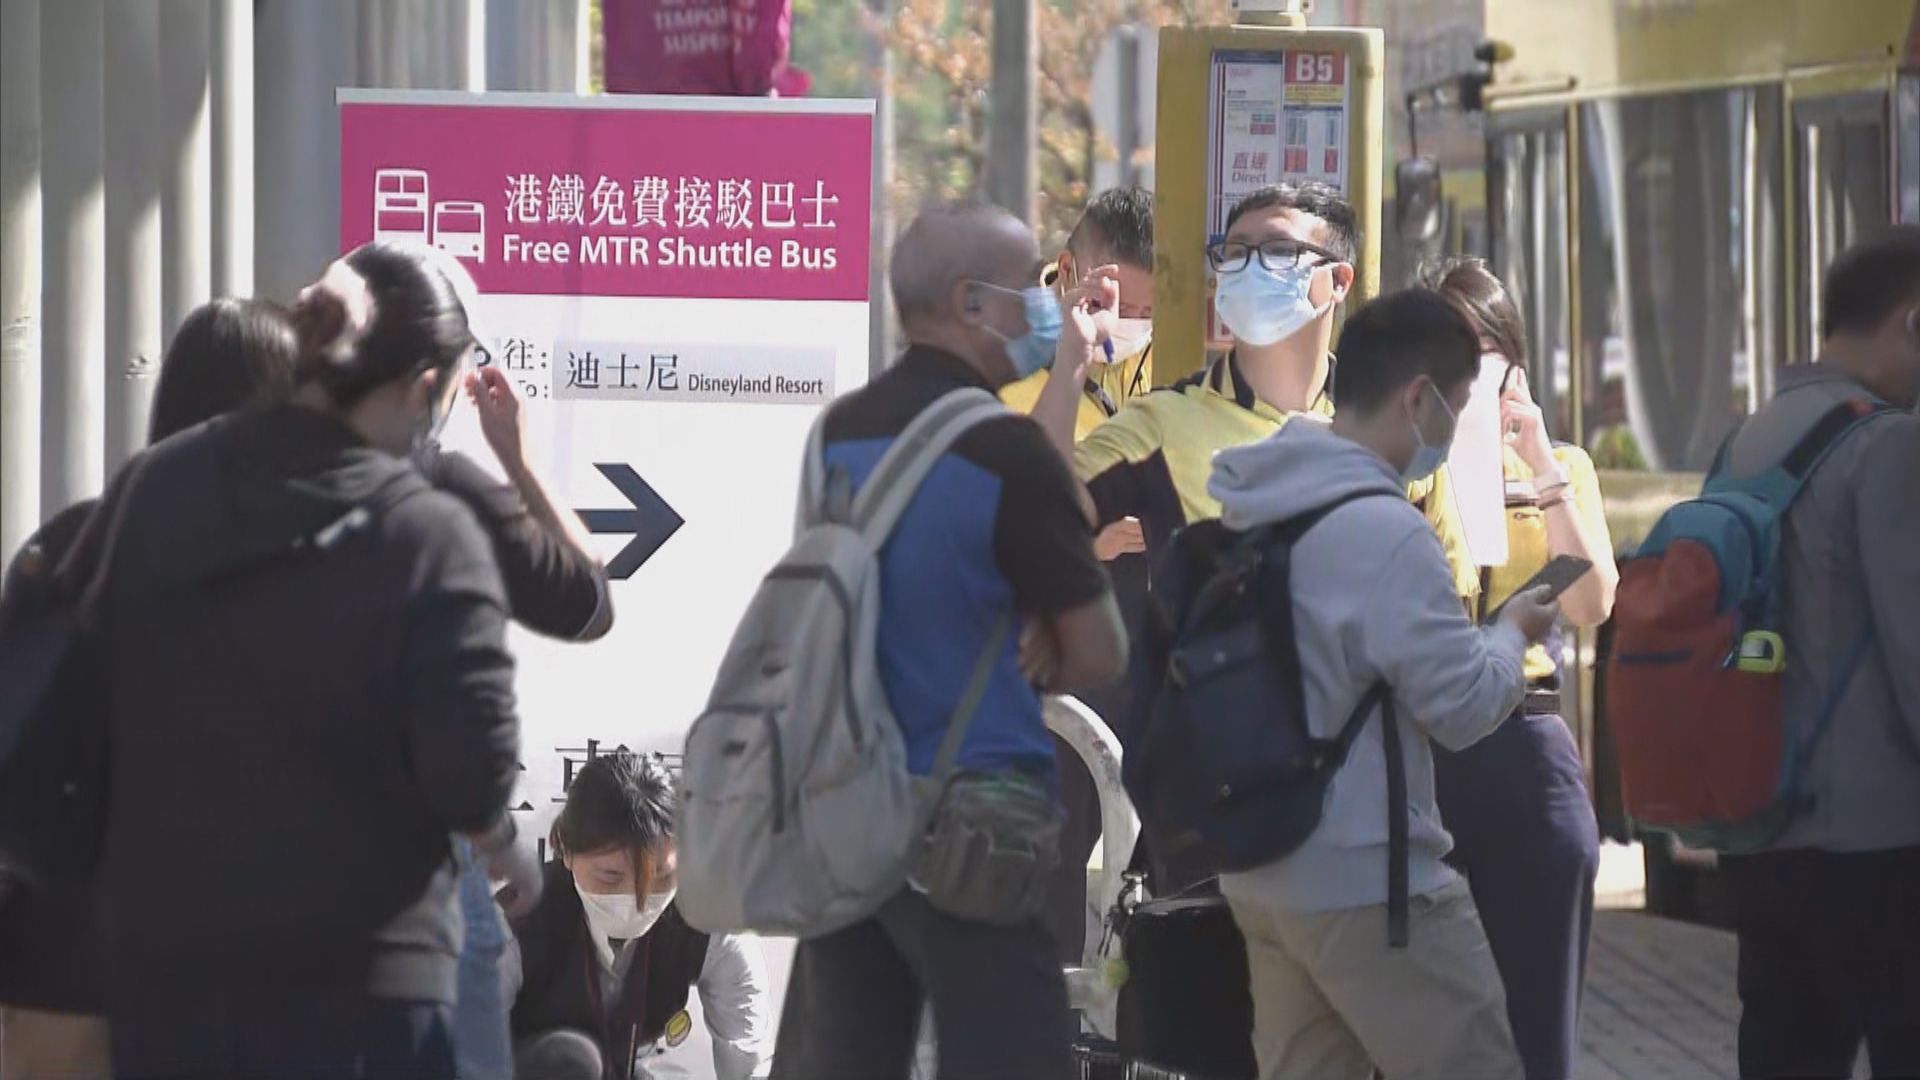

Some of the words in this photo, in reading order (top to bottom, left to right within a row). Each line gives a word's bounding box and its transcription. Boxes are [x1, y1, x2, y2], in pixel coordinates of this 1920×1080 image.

[1295, 53, 1334, 82] B5
[1231, 171, 1267, 184] Direct
[503, 173, 840, 230] 港鐵免費接駁巴士
[503, 234, 570, 263] Free
[578, 236, 649, 266] MTR
[657, 237, 773, 269] Shuttle
[781, 240, 837, 270] Bus
[565, 350, 680, 391] 迪士尼
[687, 373, 772, 395] Disneyland
[775, 375, 824, 395] Resort
